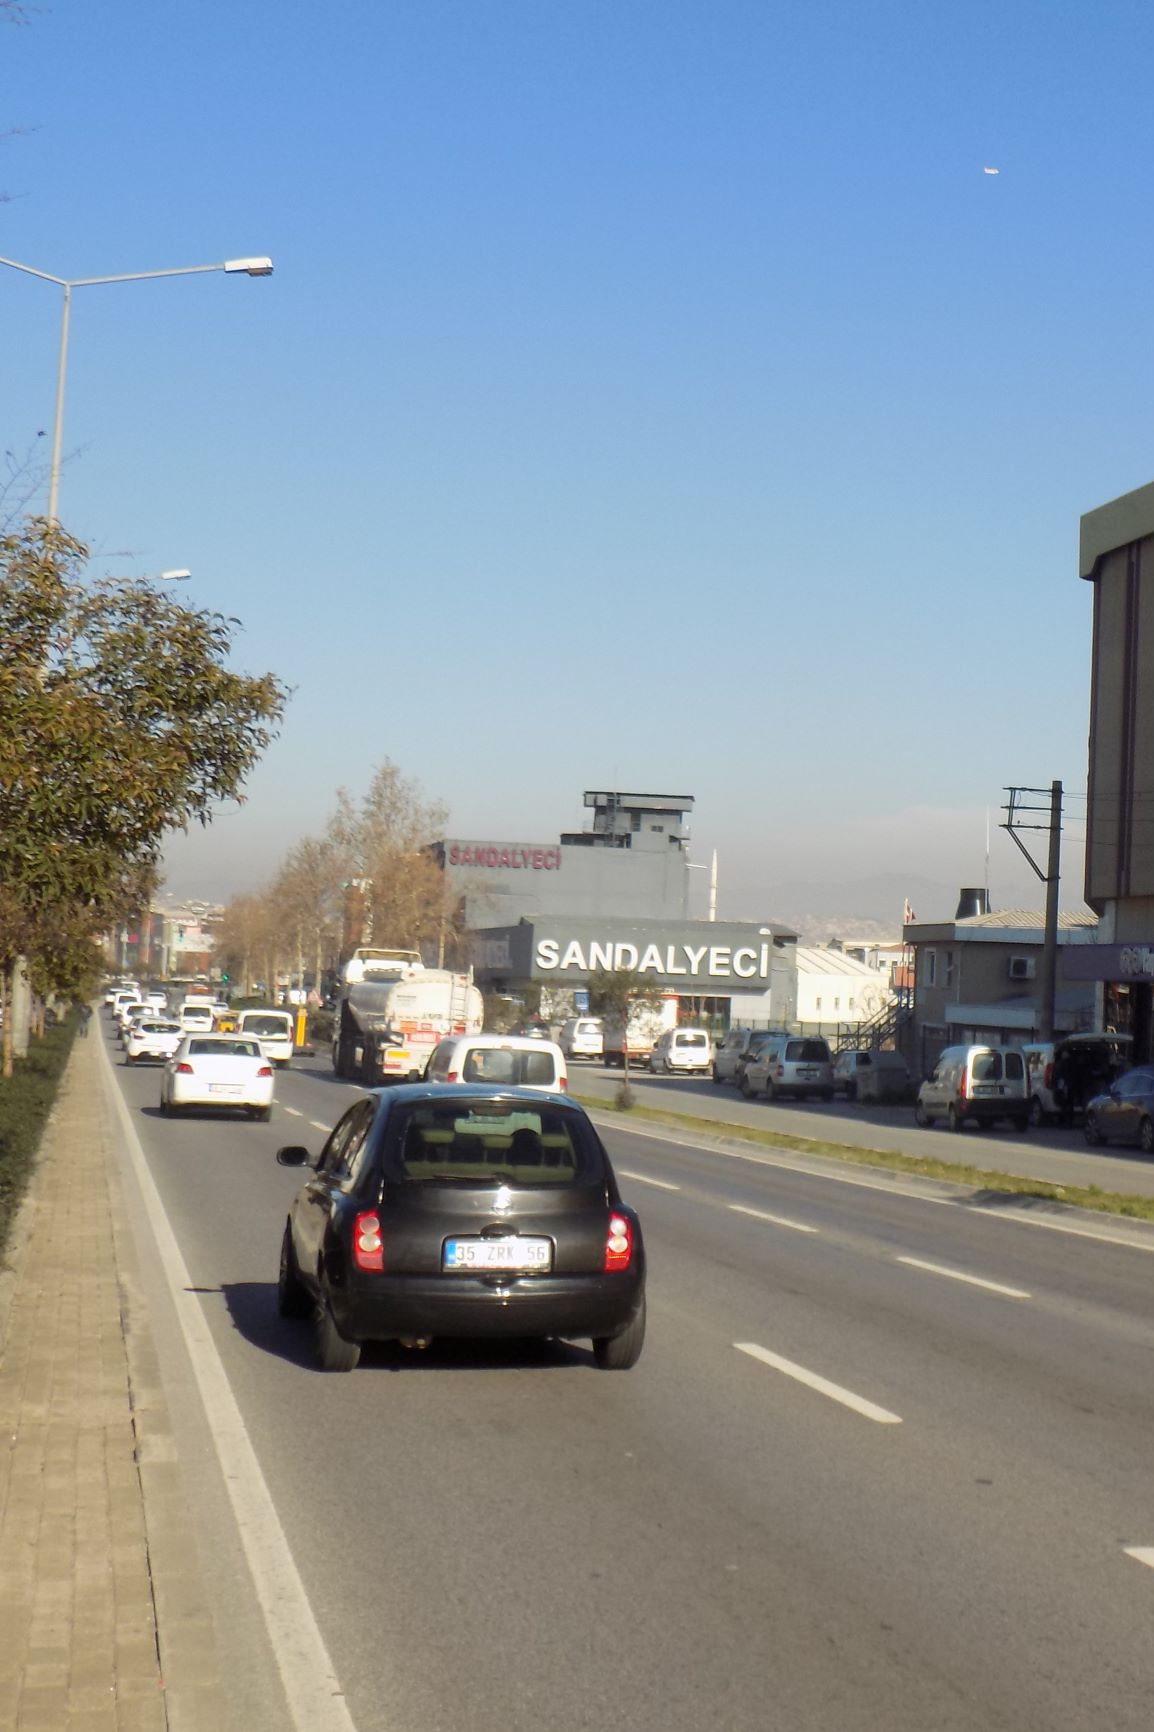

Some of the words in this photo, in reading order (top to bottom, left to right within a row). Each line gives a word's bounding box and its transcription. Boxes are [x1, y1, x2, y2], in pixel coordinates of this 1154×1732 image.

[449, 844, 562, 871] SANDALYECİ
[536, 928, 772, 978] SANDALYECİ
[457, 1246, 475, 1262] 35
